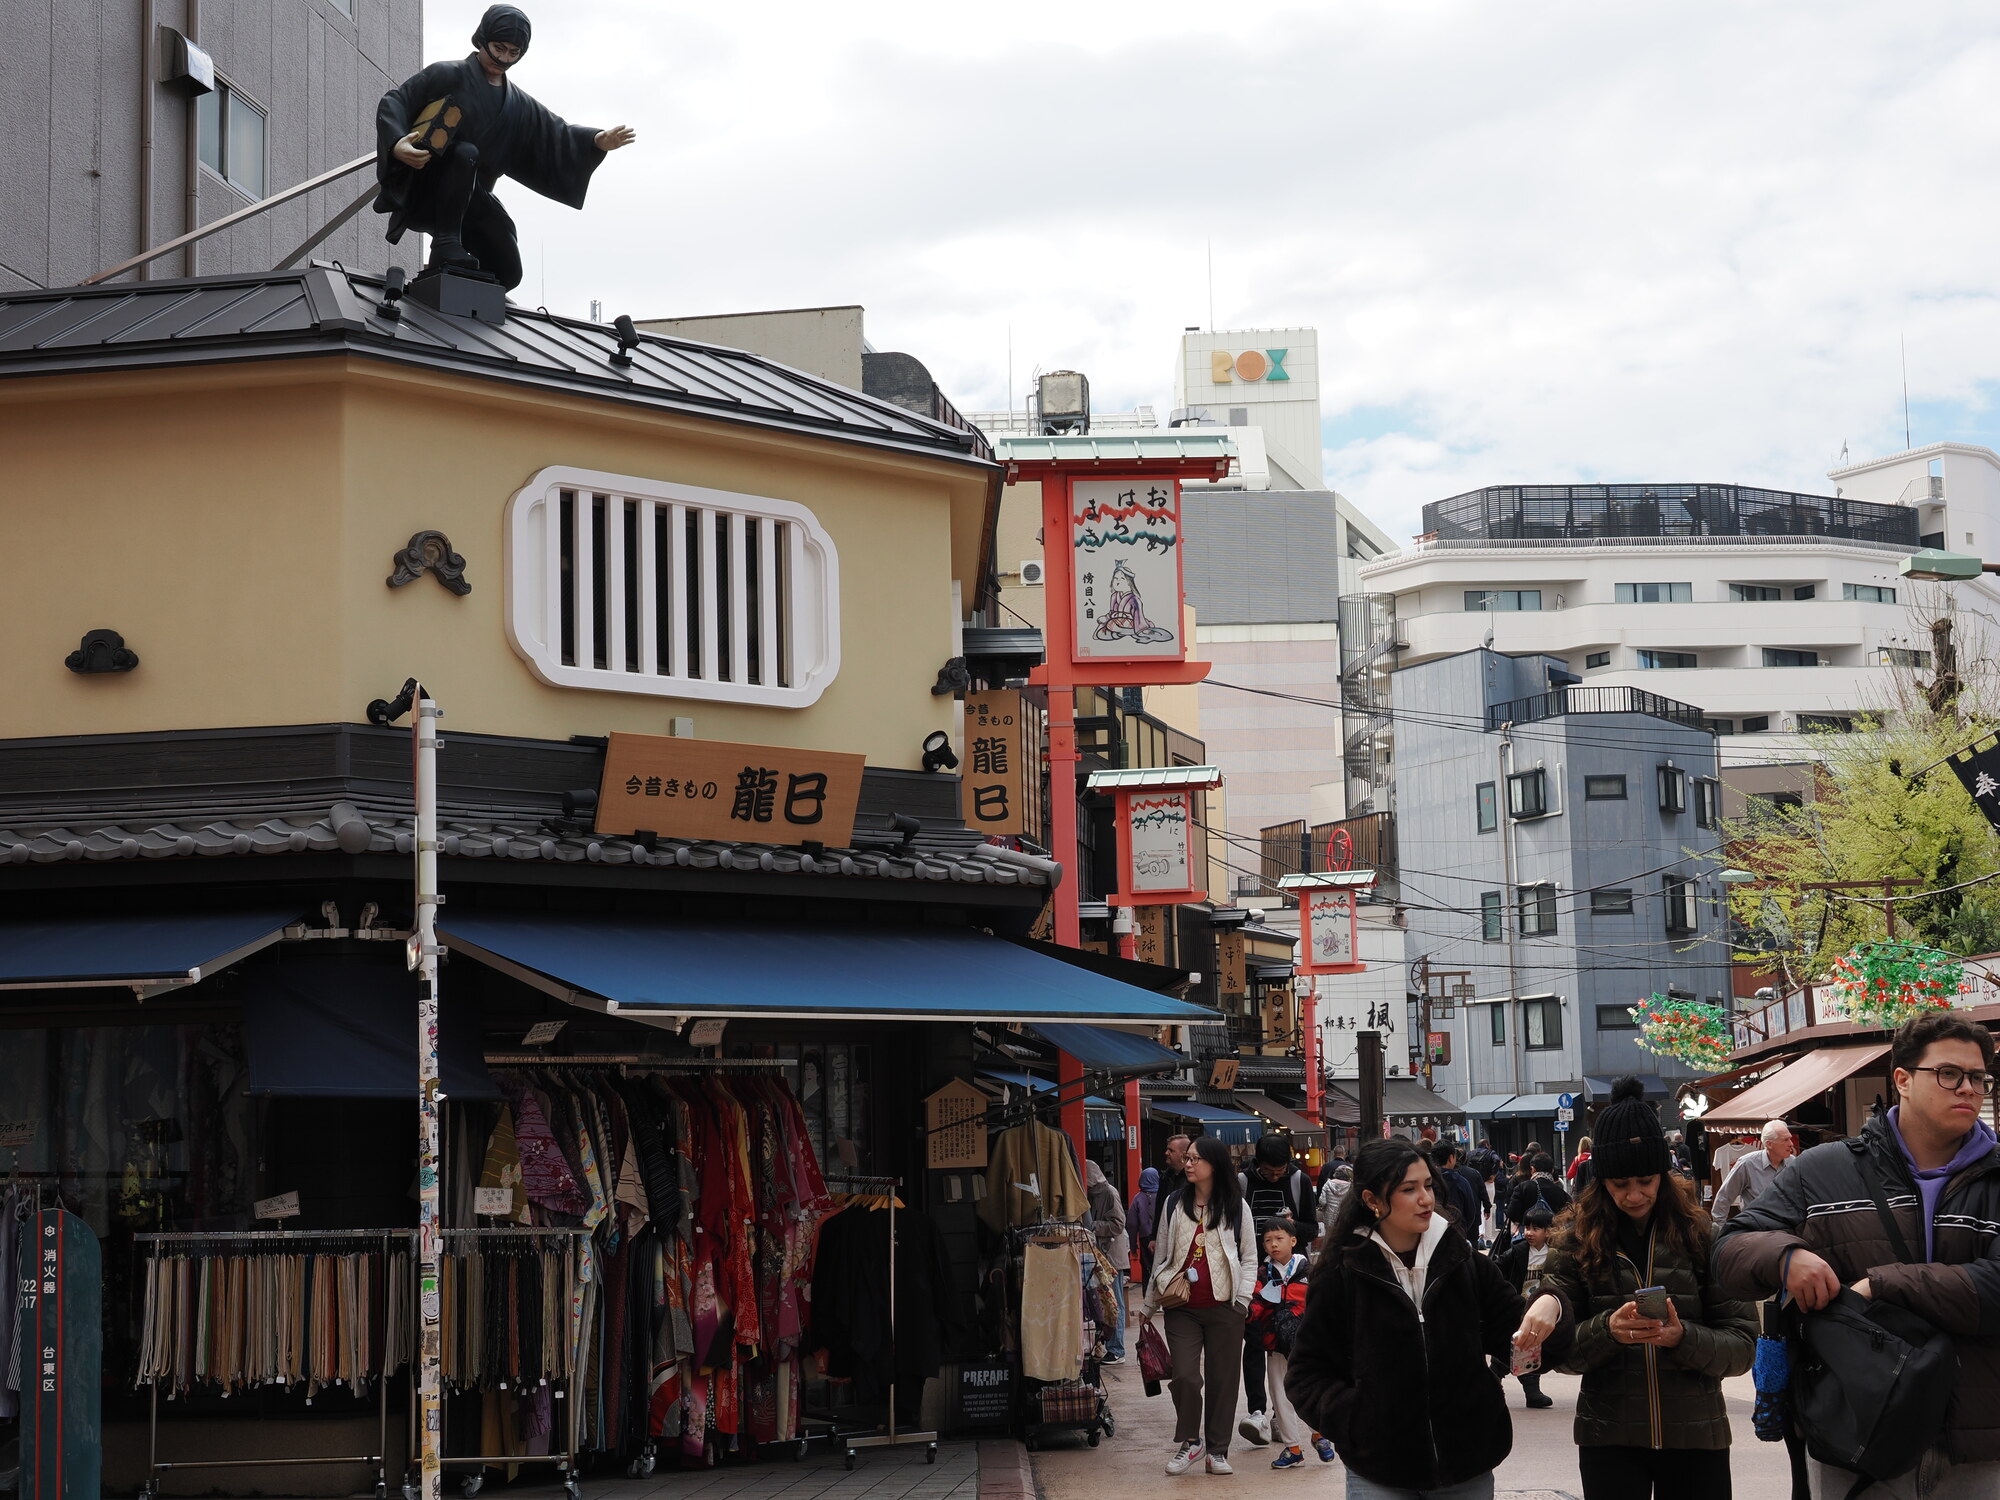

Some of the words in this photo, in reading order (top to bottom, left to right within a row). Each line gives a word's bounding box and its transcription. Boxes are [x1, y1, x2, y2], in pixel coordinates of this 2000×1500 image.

[1212, 348, 1290, 384] ROX
[1113, 489, 1136, 536] はち
[965, 703, 990, 717] 今昔
[977, 713, 1014, 727] きもの
[625, 774, 718, 801] 今昔きもの
[1324, 1015, 1357, 1031] 和菓子
[43, 1248, 57, 1295] 消火器
[43, 1346, 56, 1392] 台東区
[963, 1369, 1009, 1383] PREPARE
